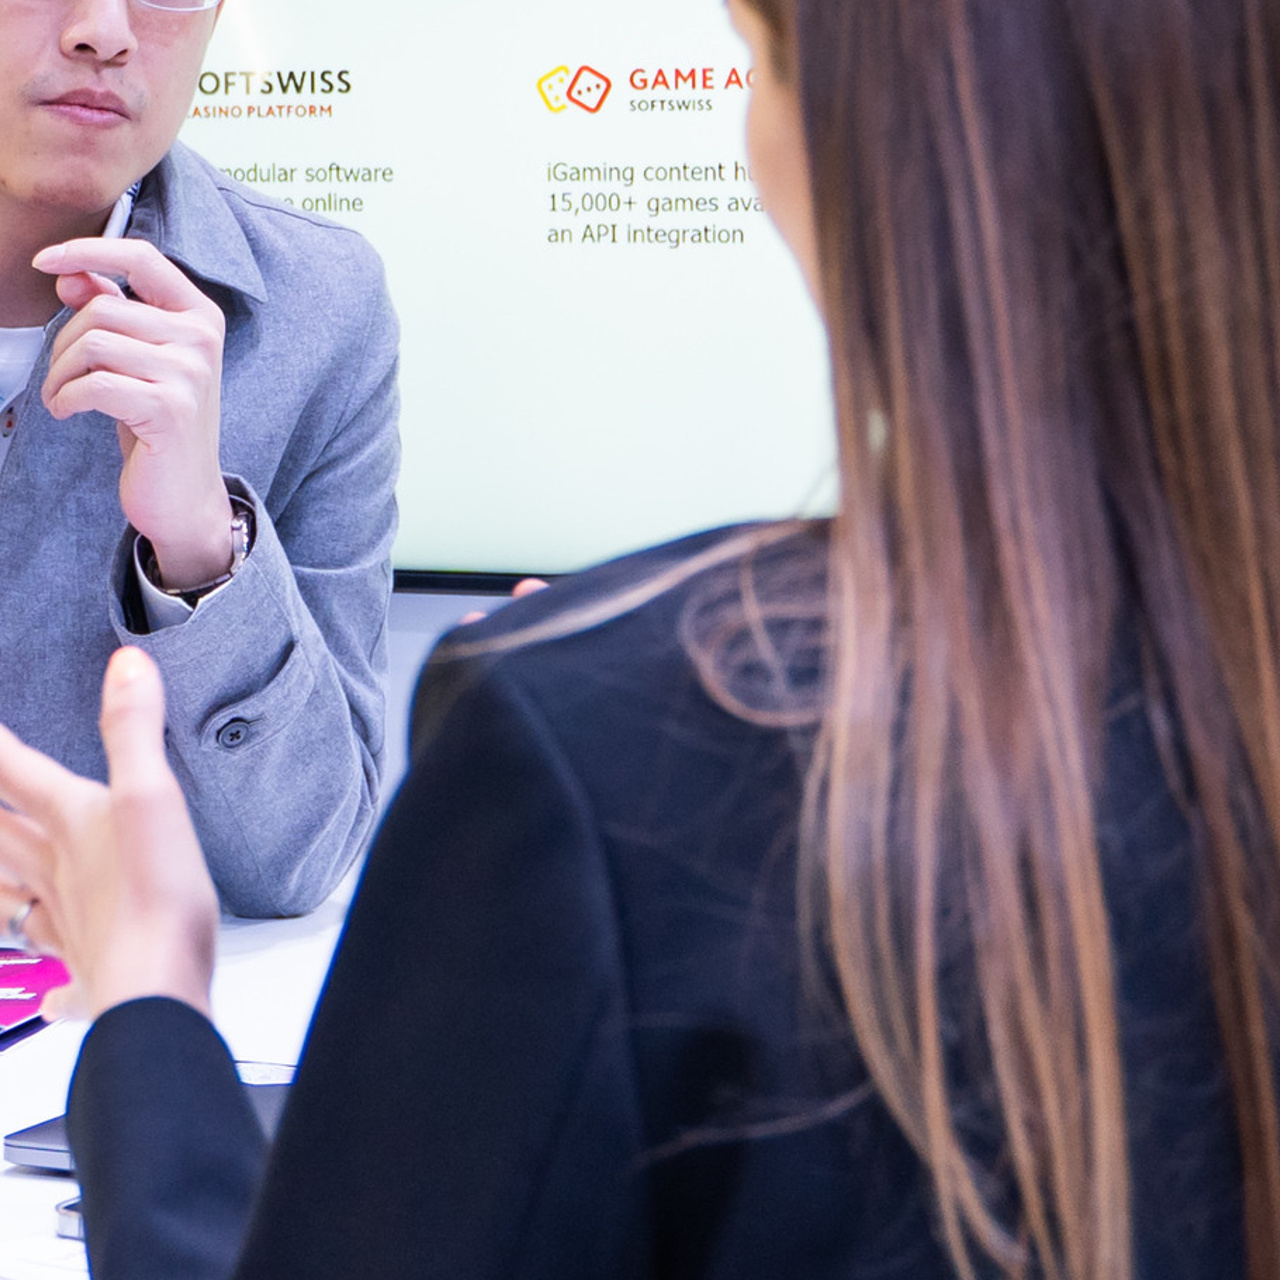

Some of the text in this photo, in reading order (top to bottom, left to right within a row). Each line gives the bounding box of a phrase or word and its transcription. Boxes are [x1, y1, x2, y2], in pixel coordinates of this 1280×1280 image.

[197, 70, 352, 95] OFTSWISS
[628, 67, 714, 91] GAME
[188, 104, 333, 118] ASINO PLATFORM
[629, 99, 713, 112] SOFTSWISS
[305, 162, 394, 183] software
[546, 161, 635, 187] iGaming
[643, 162, 726, 183] content
[301, 193, 364, 212] online
[549, 191, 638, 216] 15,000+
[647, 195, 719, 218] games
[547, 223, 745, 249] an API integration
